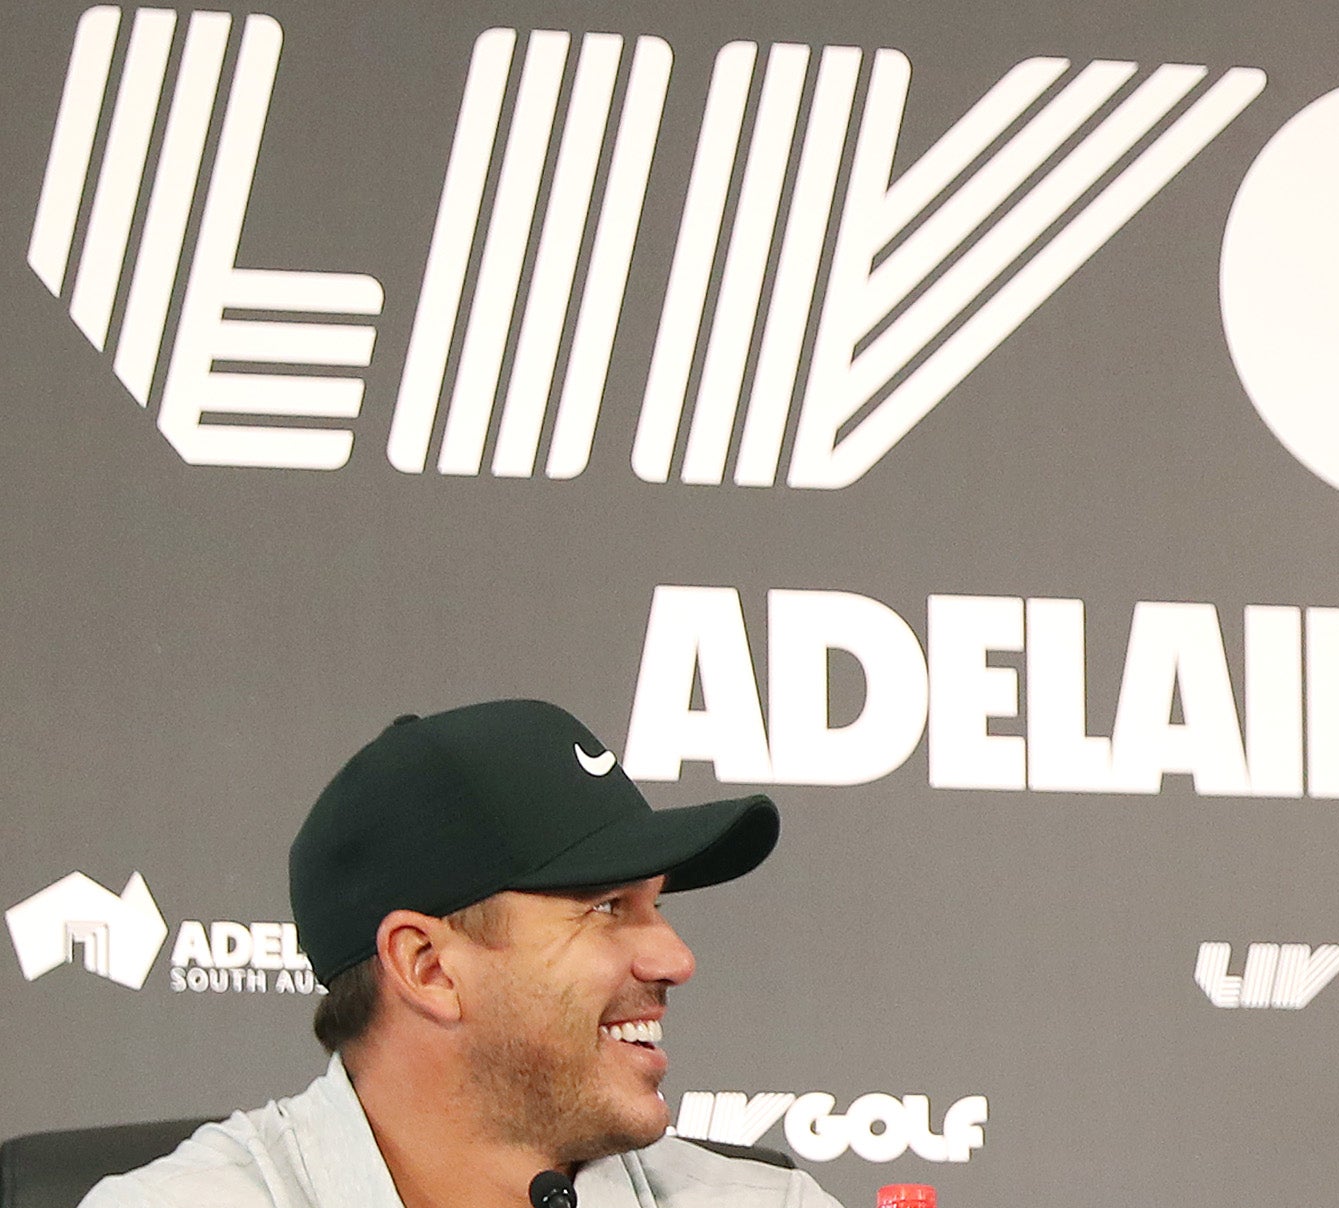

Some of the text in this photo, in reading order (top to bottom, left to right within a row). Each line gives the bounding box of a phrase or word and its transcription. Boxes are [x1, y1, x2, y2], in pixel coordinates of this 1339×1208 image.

[28, 6, 1268, 489] LIV
[170, 920, 312, 969] ADEL
[170, 966, 267, 994] SOUTH
[674, 1091, 988, 1162] IV GOLF
